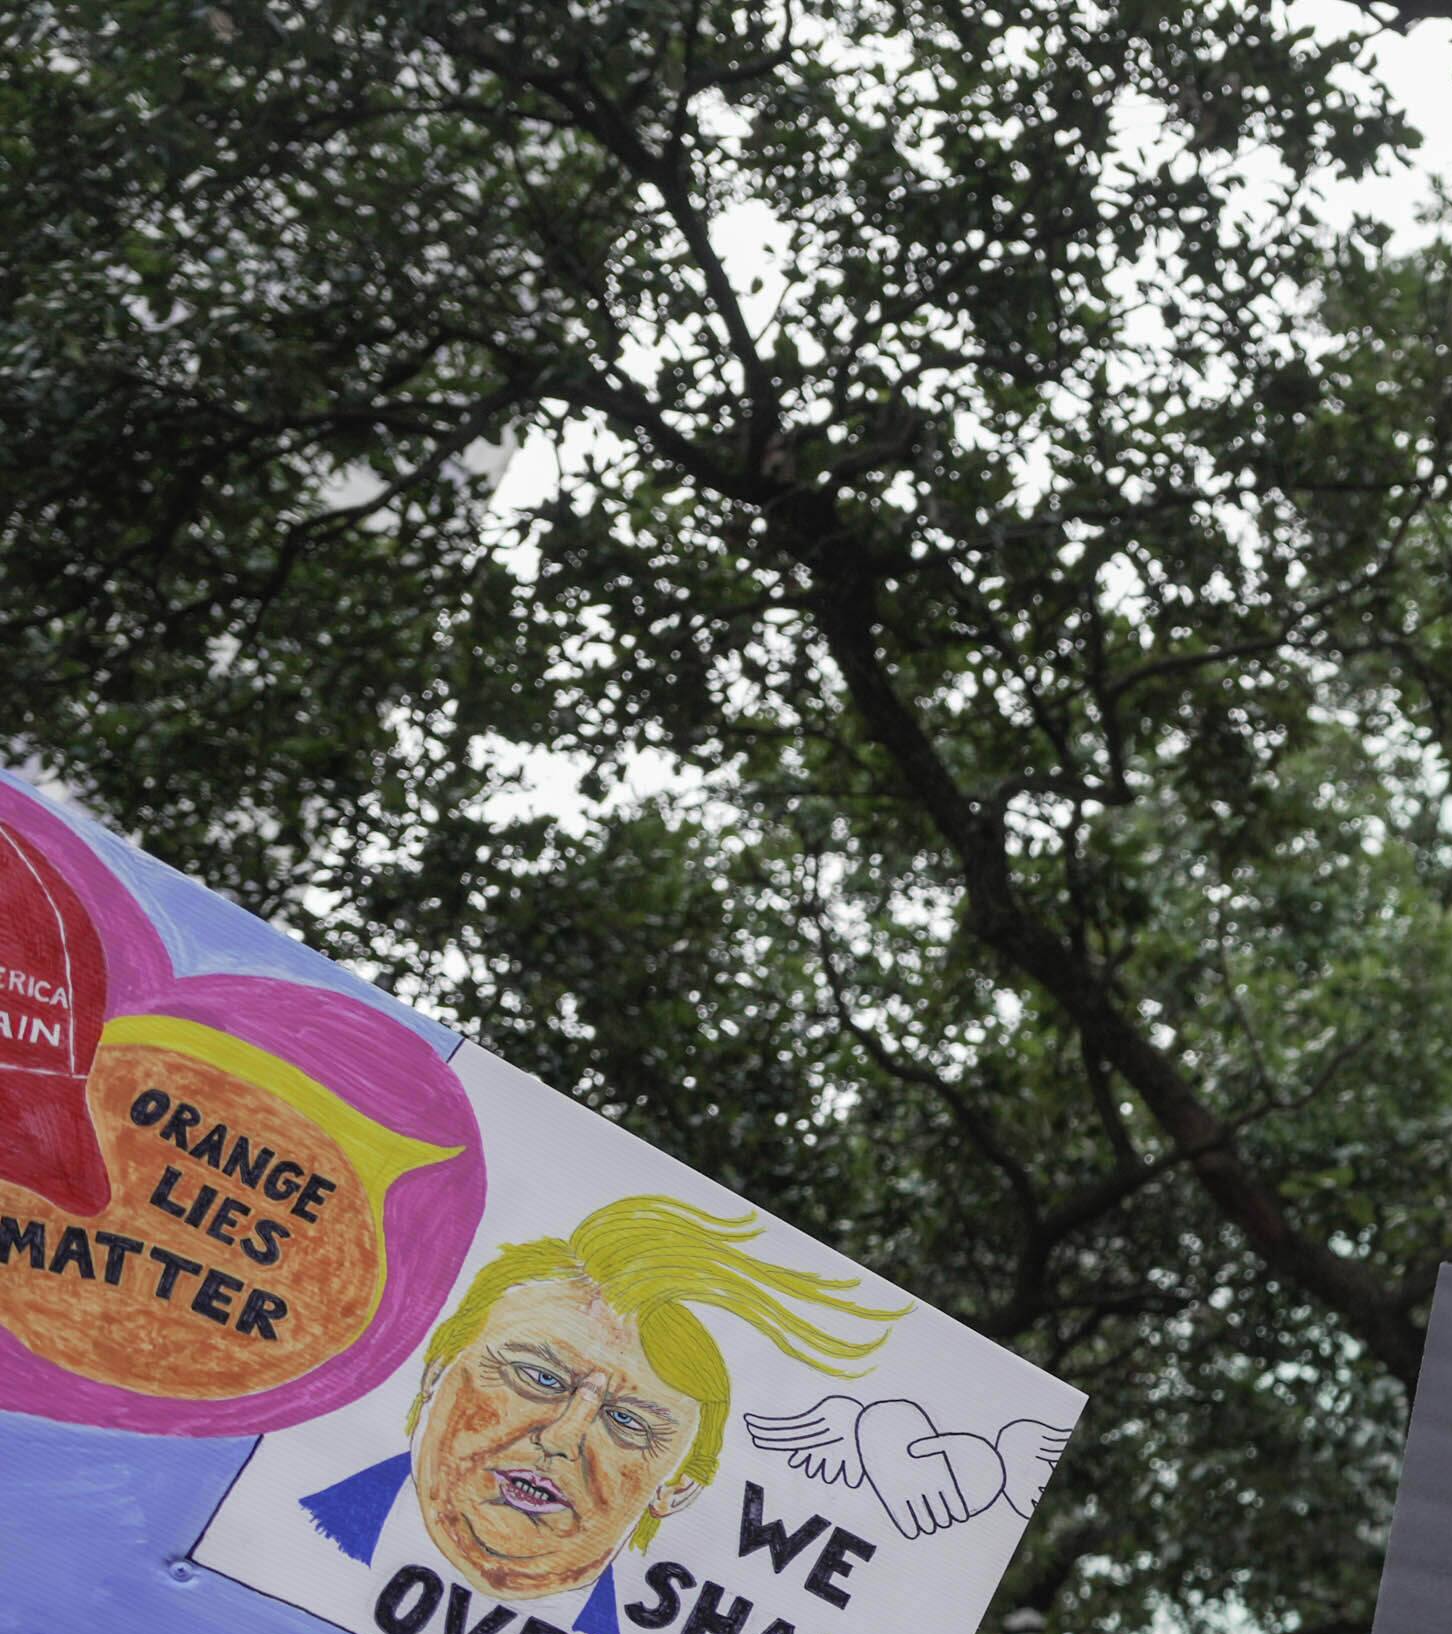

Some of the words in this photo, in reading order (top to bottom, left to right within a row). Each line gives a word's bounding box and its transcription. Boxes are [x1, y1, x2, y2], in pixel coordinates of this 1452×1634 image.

[130, 1089, 337, 1224] ORANGE
[150, 1165, 290, 1266] LIES
[1, 1216, 289, 1341] MATTER
[739, 1480, 877, 1610] WE
